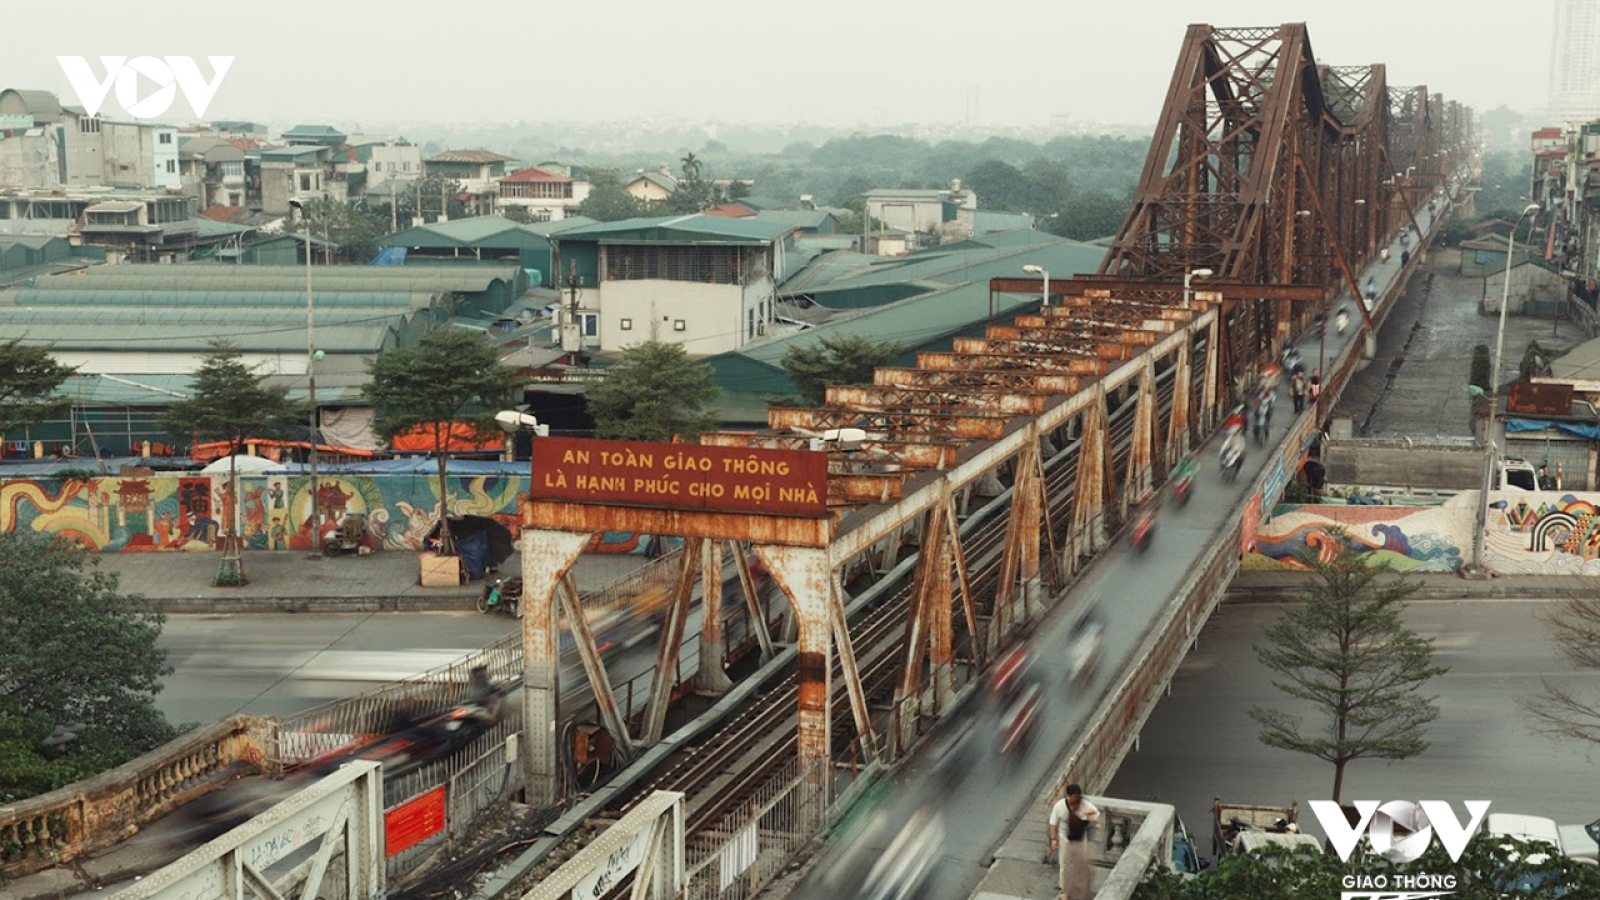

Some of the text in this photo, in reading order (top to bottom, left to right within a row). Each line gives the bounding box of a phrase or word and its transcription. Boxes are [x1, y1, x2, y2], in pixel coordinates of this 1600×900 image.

[562, 450, 590, 464] AN
[600, 448, 653, 468] TOÀN
[723, 454, 790, 476] THÔNG
[545, 469, 567, 488] LÀ
[575, 474, 625, 494] HẠNH
[634, 474, 680, 495] PHÚC
[688, 482, 725, 498] CHO
[779, 482, 819, 503] NHÀ
